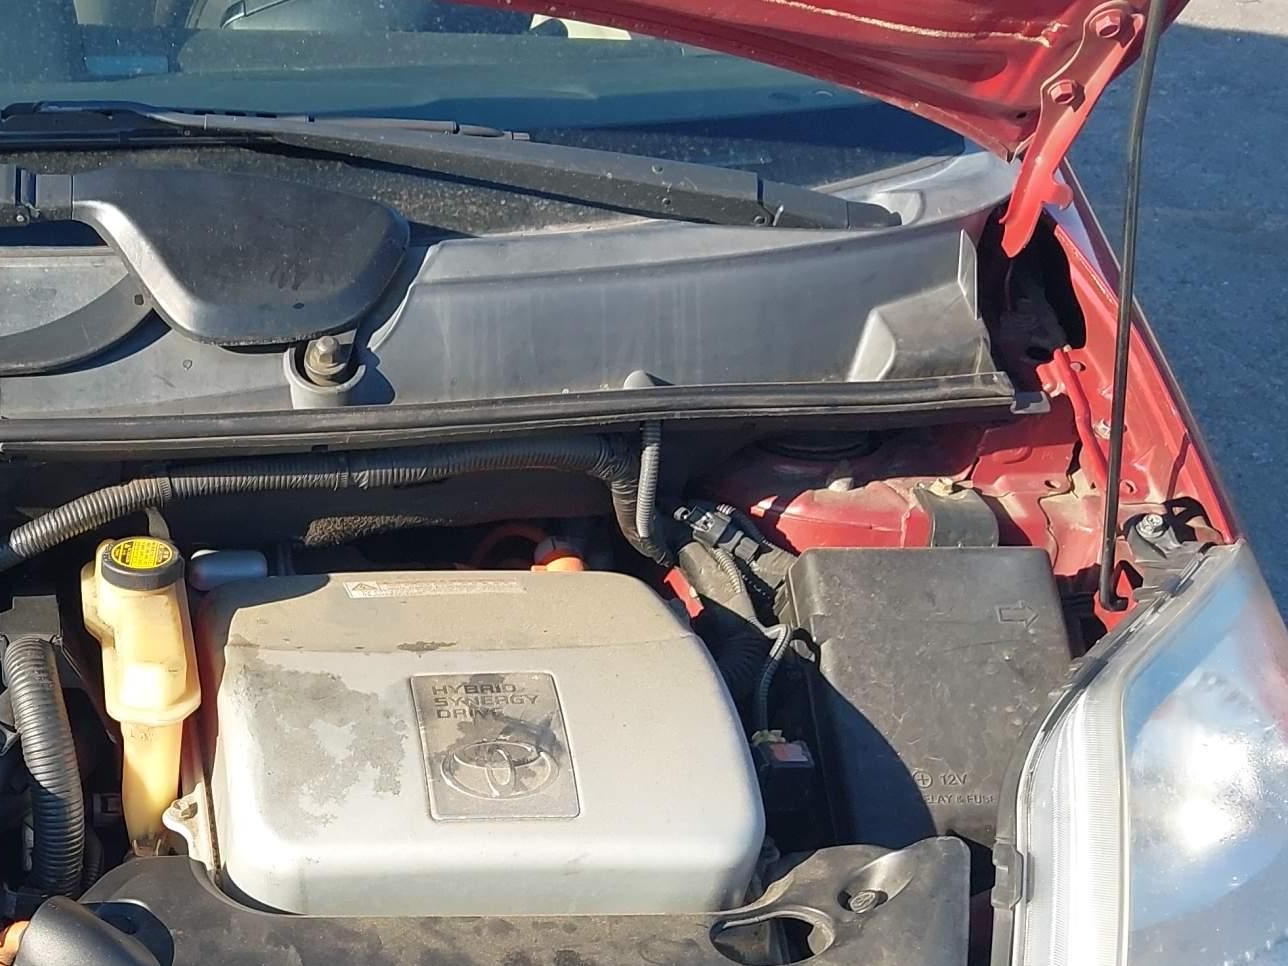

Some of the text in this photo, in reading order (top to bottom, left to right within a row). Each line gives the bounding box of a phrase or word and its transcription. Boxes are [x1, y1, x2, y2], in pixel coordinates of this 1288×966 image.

[432, 683, 517, 695] HYBRID
[434, 695, 539, 707] SYNERGY
[940, 773, 968, 787] 12V
